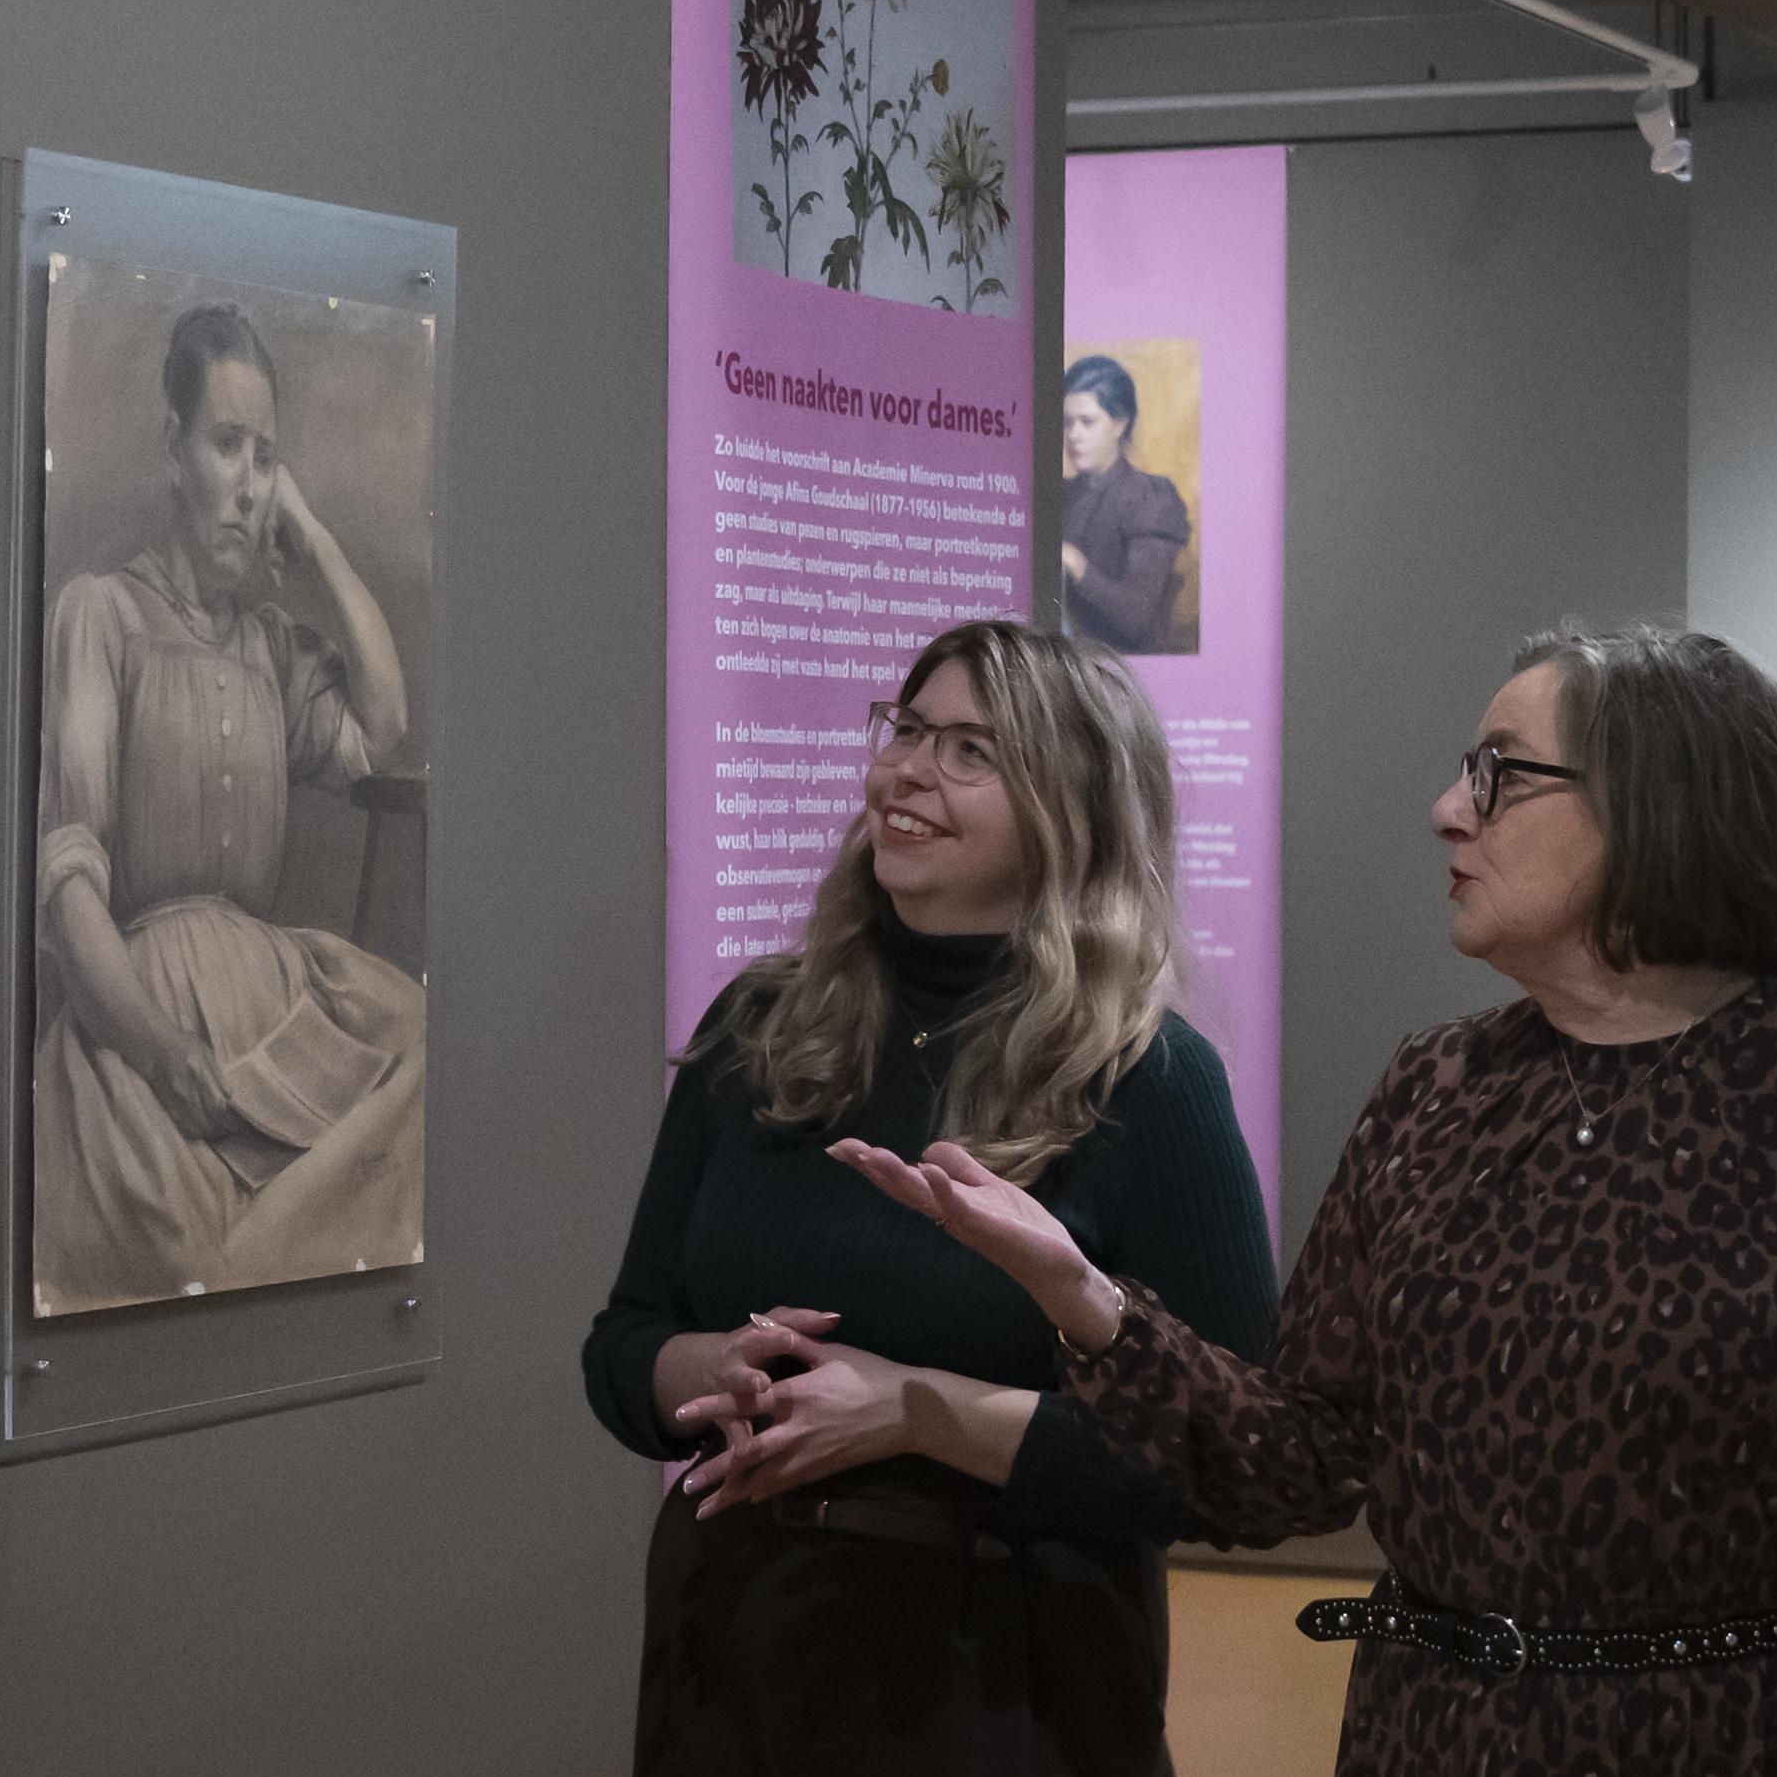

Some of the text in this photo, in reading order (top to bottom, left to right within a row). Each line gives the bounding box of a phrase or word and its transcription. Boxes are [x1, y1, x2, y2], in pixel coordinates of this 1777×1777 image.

[781, 368, 863, 418] naakten
[869, 390, 922, 426] voor
[714, 433, 733, 455] Zo
[735, 435, 765, 462] luidde
[765, 441, 781, 464] het
[831, 458, 851, 475] aan
[853, 456, 908, 484] Academie
[909, 465, 954, 488] Minerva
[956, 472, 984, 490] rond
[714, 470, 745, 493] Voor
[746, 474, 759, 496] de
[759, 475, 784, 504] jonge
[811, 485, 869, 511] Goudschaal
[943, 501, 1006, 525] betekende
[1008, 507, 1026, 528] dat
[715, 511, 747, 533] geen
[779, 519, 797, 536] van
[826, 527, 839, 542] en
[840, 526, 903, 551] rugspieren,
[906, 535, 932, 551] maar
[934, 536, 1019, 563] portretkoppen
[715, 547, 733, 563] en
[804, 553, 871, 583] onderwerpen
[872, 560, 891, 581] die
[893, 566, 907, 583] ze
[909, 565, 930, 584] niet
[932, 565, 948, 586] als
[950, 566, 1012, 596] beperking
[715, 583, 743, 606] zag,
[744, 584, 767, 602] maar
[826, 589, 862, 618] Terwijl
[863, 592, 888, 613] haar
[889, 597, 952, 624] mannelijke
[714, 615, 739, 636] ten
[741, 615, 759, 637] zich
[760, 616, 788, 644] bogen
[789, 624, 810, 641] over
[810, 622, 822, 643] de
[822, 626, 871, 646] anatomie
[872, 631, 893, 647] van
[895, 627, 915, 649] het
[715, 650, 770, 674] ontleedde
[824, 656, 850, 678] hand
[851, 658, 870, 680] het
[871, 661, 895, 686] spel
[716, 721, 731, 742] In
[734, 720, 750, 743] de
[716, 757, 759, 784] mietijd
[811, 759, 859, 785] gebleven,
[716, 792, 758, 820] kelijke
[832, 798, 847, 814] en
[716, 831, 752, 853] wust,
[716, 905, 745, 922] een
[716, 936, 741, 958] die
[744, 935, 765, 957] later
